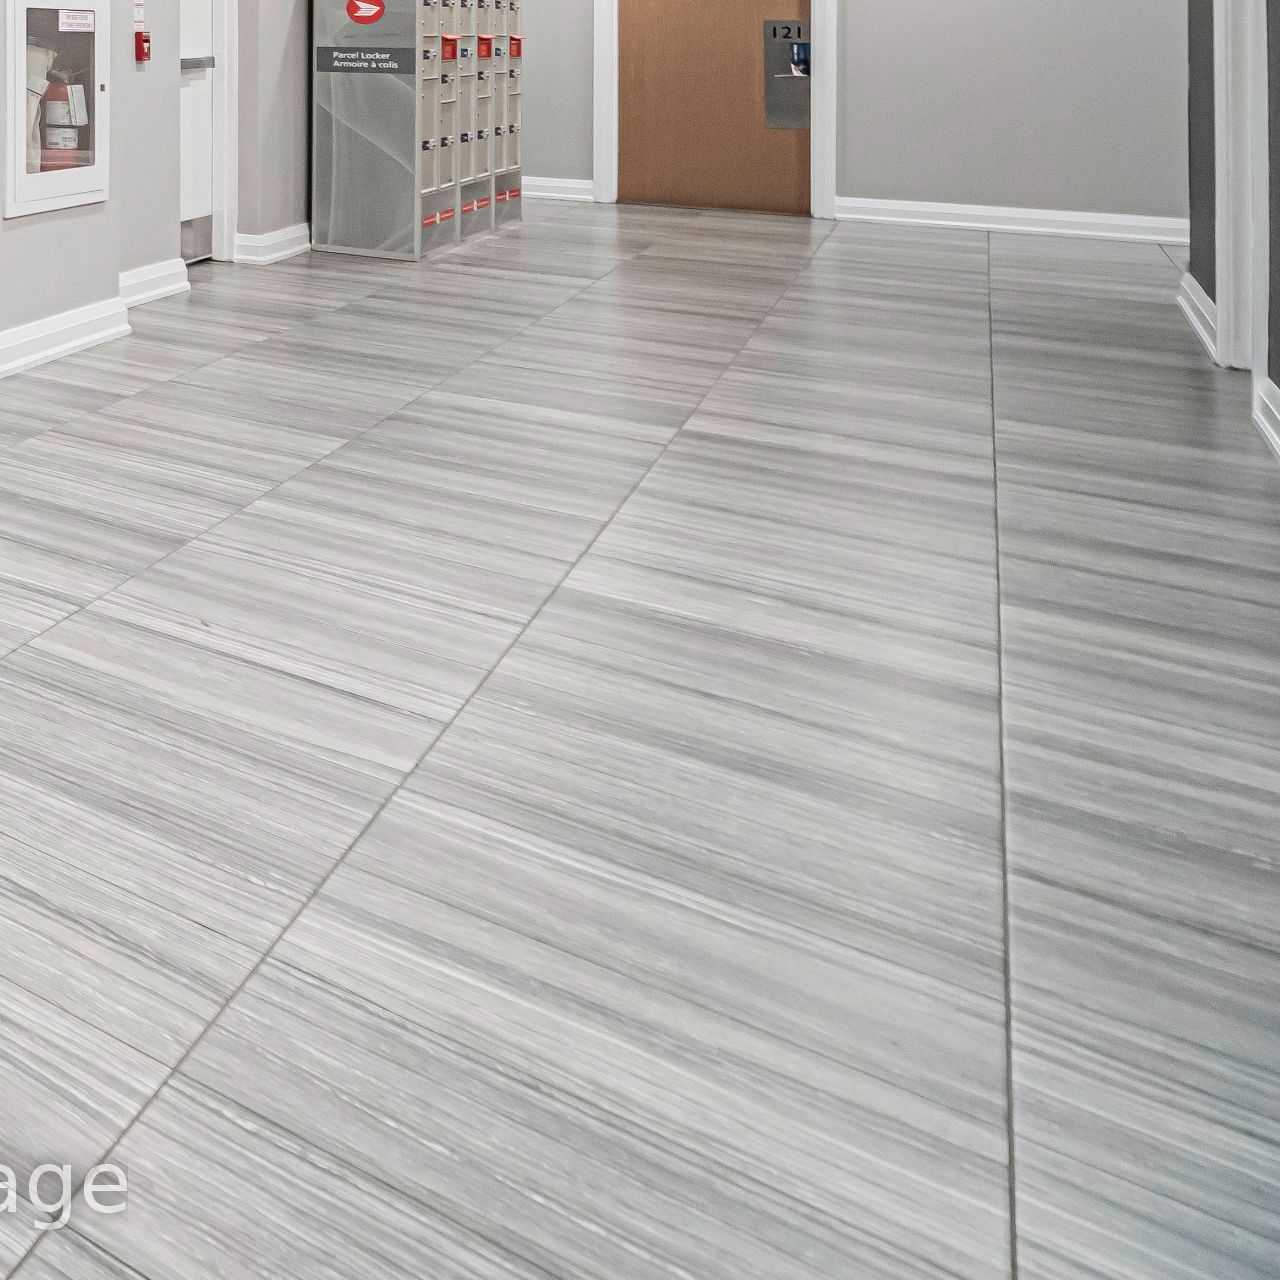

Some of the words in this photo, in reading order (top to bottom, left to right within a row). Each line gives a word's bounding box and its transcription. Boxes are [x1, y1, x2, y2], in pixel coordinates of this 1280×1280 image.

[773, 26, 801, 39] 121
[333, 51, 359, 59] Parcel
[361, 52, 391, 60] Locker
[333, 60, 369, 68] Armoire
[378, 61, 399, 69] colis
